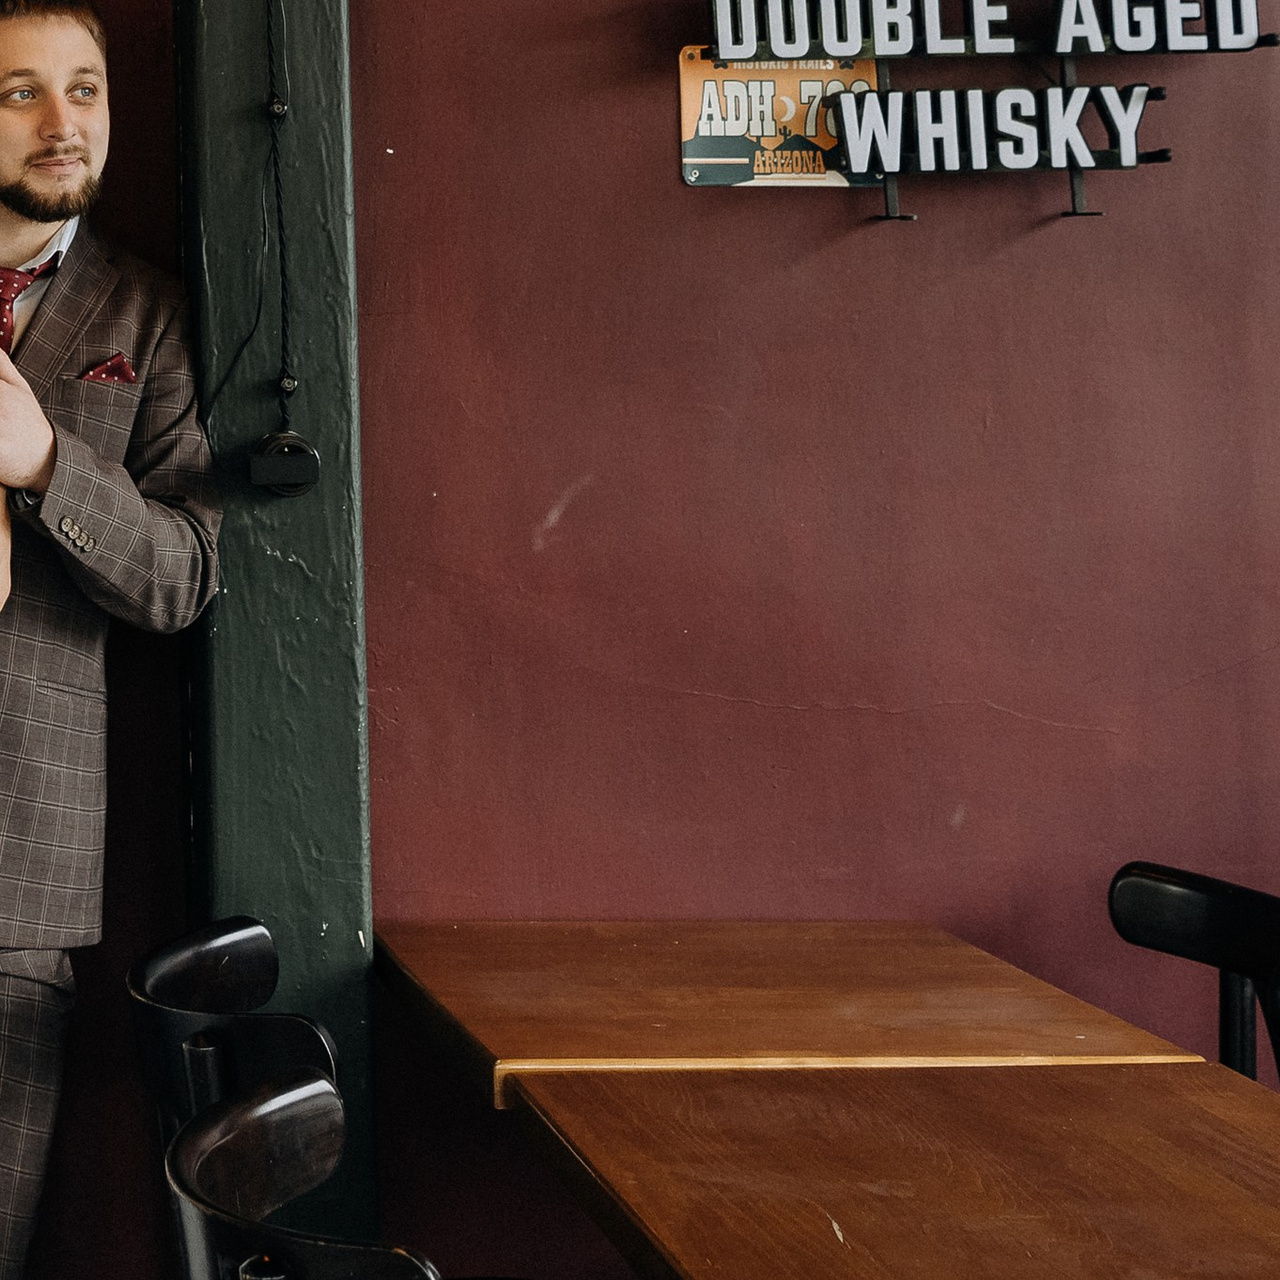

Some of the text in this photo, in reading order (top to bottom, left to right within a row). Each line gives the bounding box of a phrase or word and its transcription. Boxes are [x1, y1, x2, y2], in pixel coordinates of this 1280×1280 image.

[698, 80, 777, 137] ADH
[840, 86, 1149, 173] WHISKY
[753, 150, 826, 174] ARIZONA
